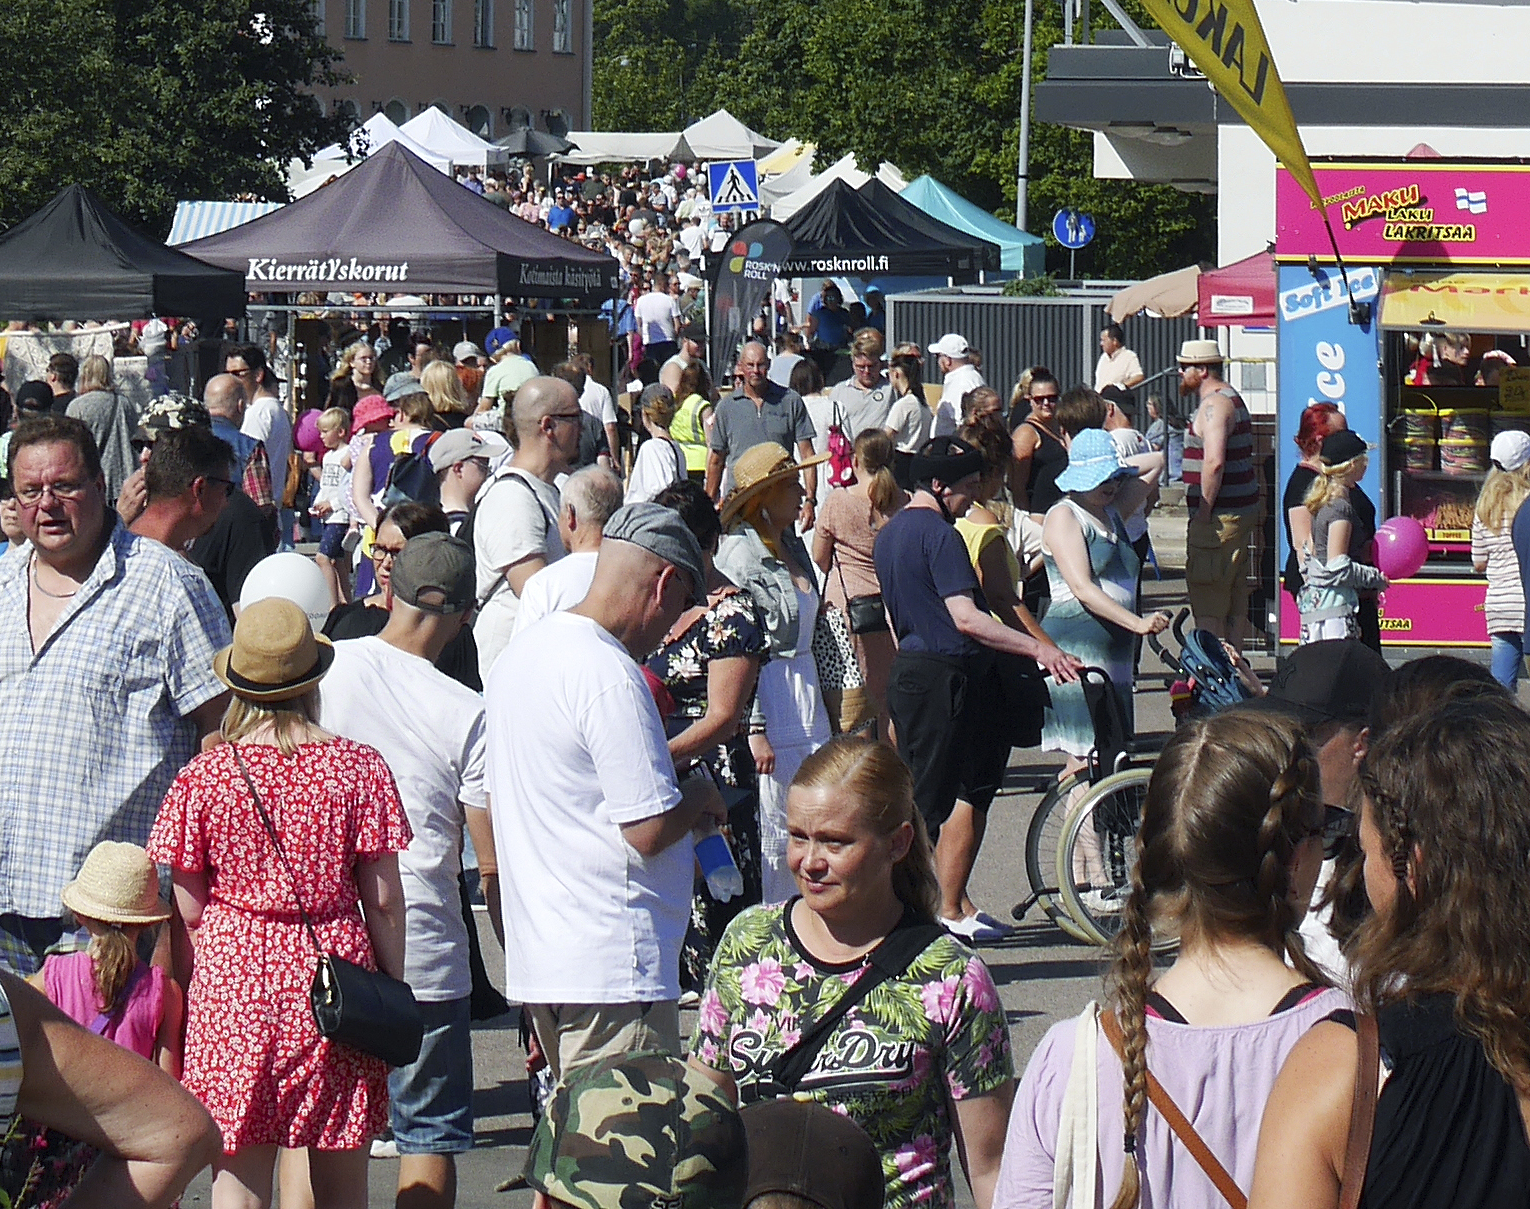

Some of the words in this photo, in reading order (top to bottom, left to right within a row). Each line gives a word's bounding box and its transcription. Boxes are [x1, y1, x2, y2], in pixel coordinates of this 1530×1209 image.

[1342, 184, 1420, 221] MAKU
[1386, 208, 1434, 222] LAKU
[1383, 224, 1476, 241] LAKRITSAA
[780, 255, 889, 272] ww.rosknroll.fi
[744, 269, 767, 280] ROLL
[1285, 284, 1333, 313] Soft
[1338, 274, 1375, 296] Ice
